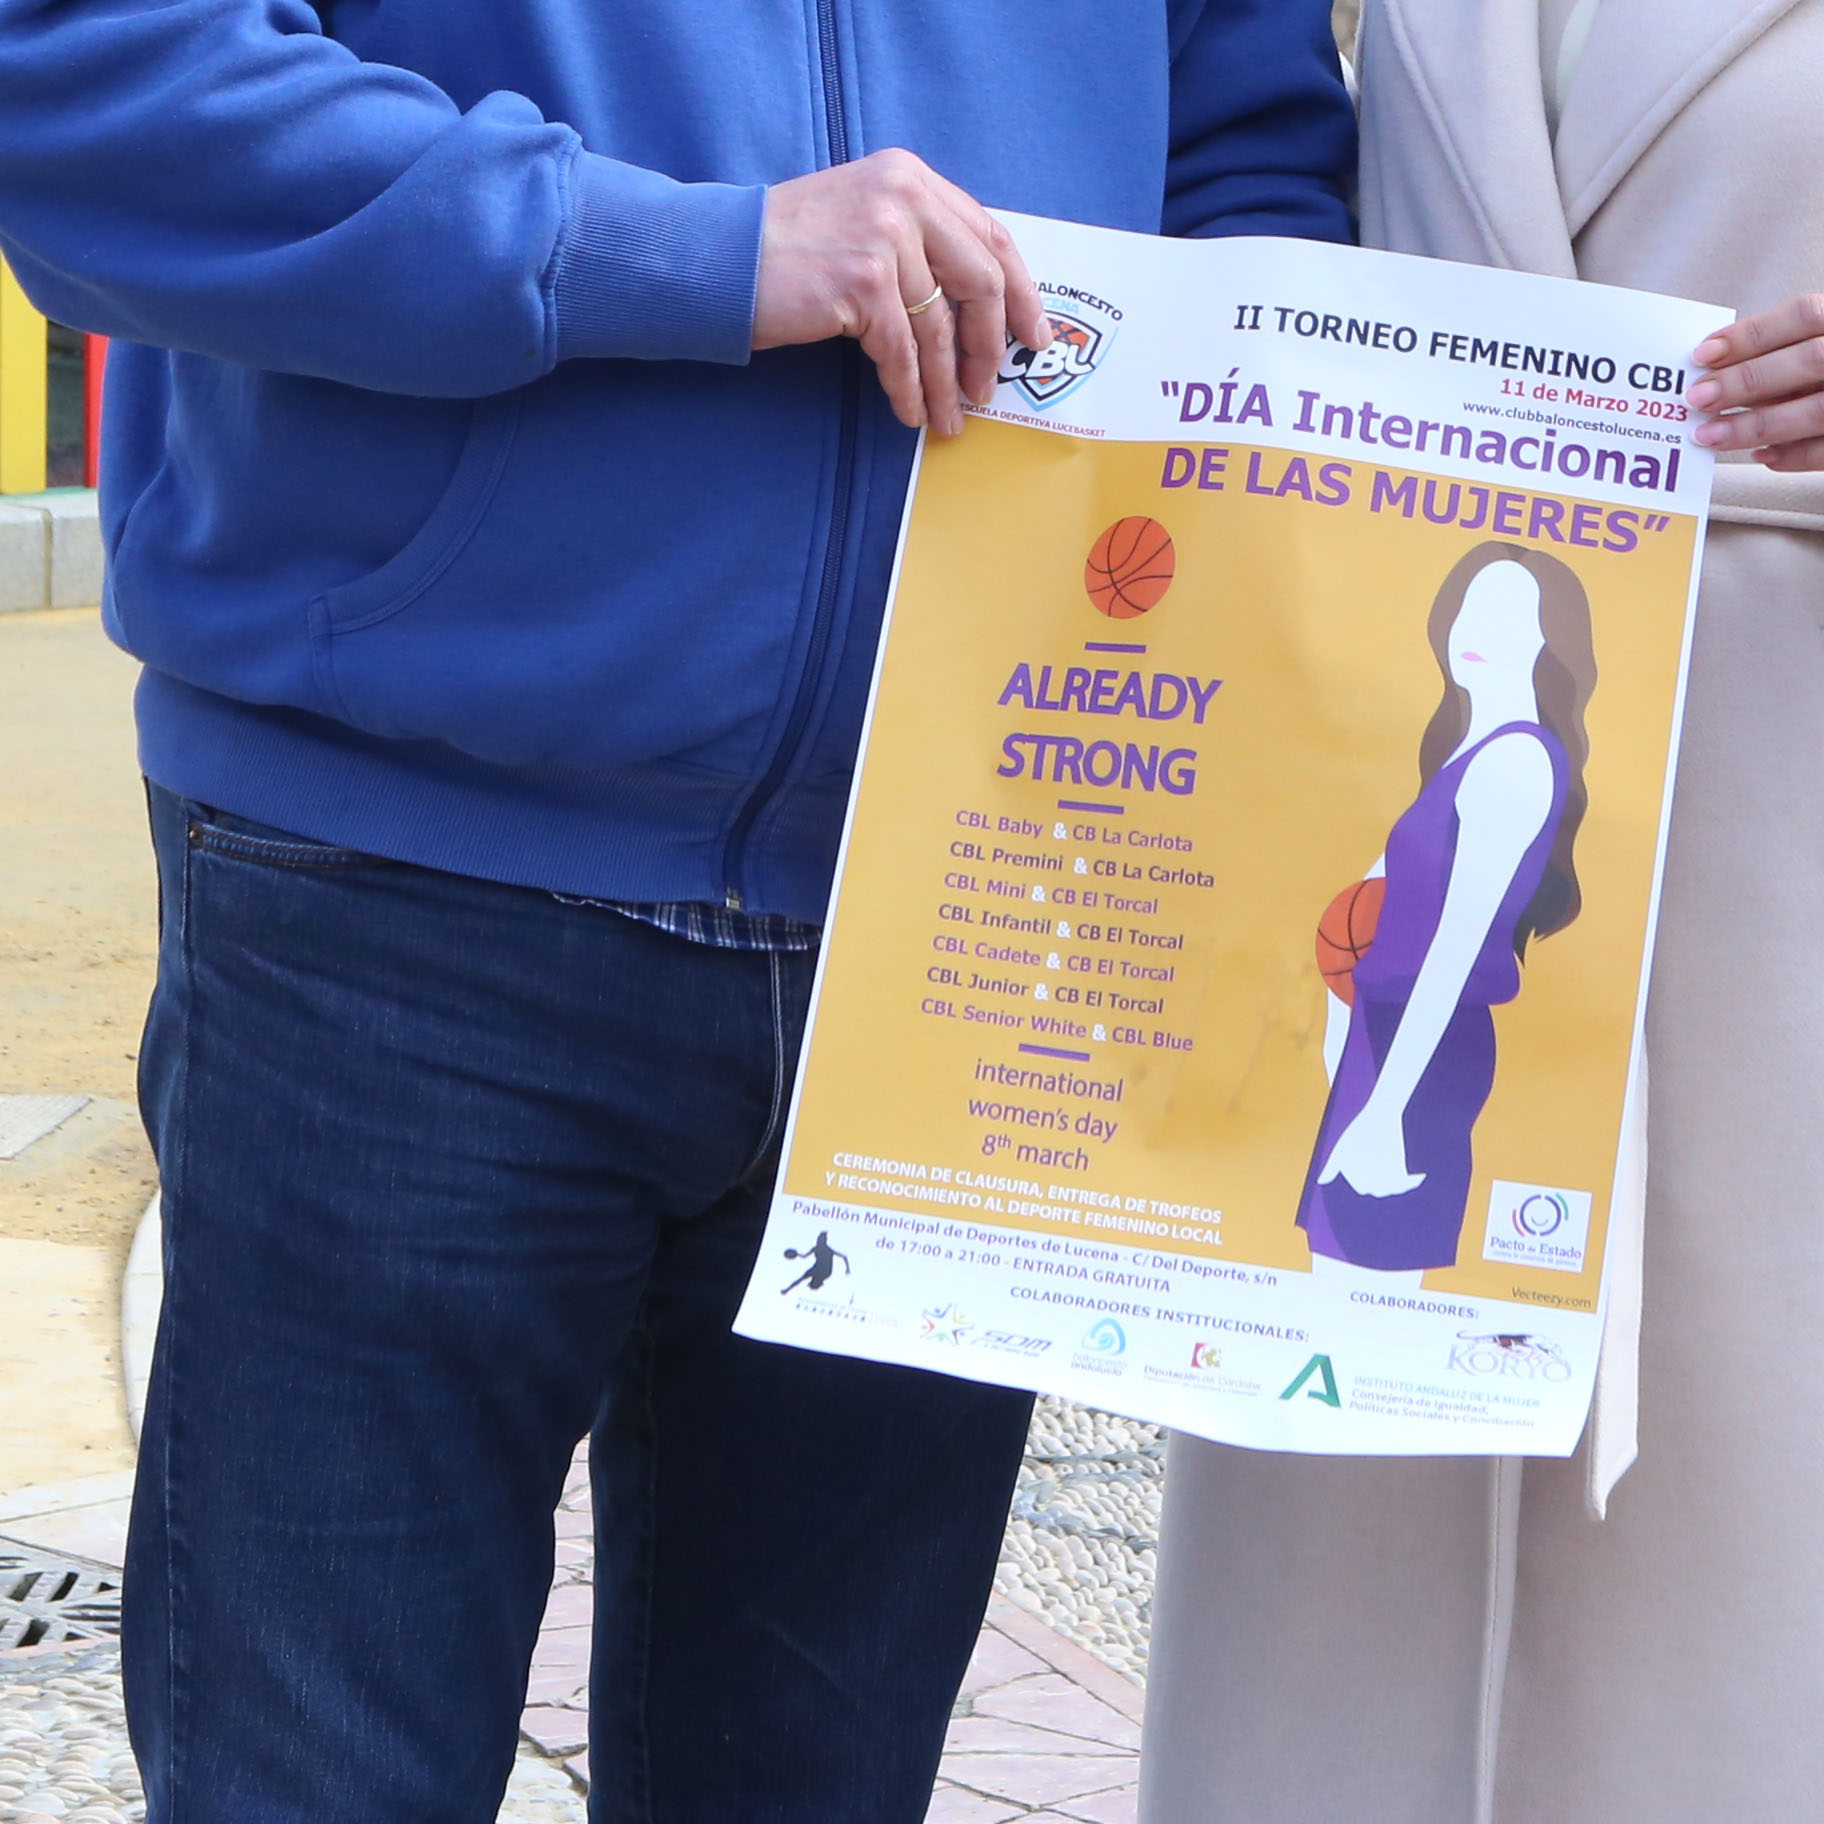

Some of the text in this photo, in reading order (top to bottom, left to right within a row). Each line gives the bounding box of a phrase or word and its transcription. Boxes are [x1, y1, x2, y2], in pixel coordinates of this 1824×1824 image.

[1033, 281, 1123, 321] ALONCESTO
[1233, 305, 1264, 330] II
[1274, 306, 1418, 353] TORNEO
[1429, 332, 1616, 384] FEMENINO
[960, 403, 1106, 438] ESCUELA DEPORTIVA LUCEBASKET
[1500, 378, 1688, 422] 11 de Marzo 2023
[1293, 389, 1681, 493] Internacional
[1463, 402, 1682, 444] www.clubbaloncestolucena.es
[1160, 448, 1229, 491] DE
[1245, 451, 1352, 507] LAS
[997, 662, 1224, 725] ALREADY
[997, 732, 1198, 796] STRONG
[955, 809, 1193, 852] CBL Baby & CB La Carlota
[949, 841, 1215, 888] CBL Premini & CB La Carlota
[944, 872, 1159, 914] CBL Mini & CB El Torcal
[938, 904, 1184, 951] CBL Infantil & CB El Torcal
[932, 935, 1175, 982] CBL Cadete & CB El Torcal
[926, 966, 1164, 1014] CBL Junior & CB El Torcal
[920, 998, 1194, 1052] CBL Senior White & CBL Blue
[975, 1058, 1124, 1102] international
[1074, 1111, 1119, 1144] day
[980, 1133, 1089, 1171] 8th march
[824, 1171, 1225, 1246] Y RECONOCIMIENTO AL DEPORTE FEMENINO LOCAL
[832, 1151, 1223, 1225] CEREMONIA DE CLAUSURA, ENTREGA DE TROFEOS
[792, 1200, 861, 1224] Pabellón
[863, 1211, 941, 1236] Municipal
[943, 1223, 964, 1239] de
[966, 1226, 1038, 1250] Deportes
[1041, 1239, 1061, 1254] de
[1064, 1241, 1119, 1262] Lucena
[1132, 1252, 1150, 1267] C/
[1152, 1254, 1178, 1272] Del
[1181, 1260, 1251, 1284] Deporte,
[1253, 1271, 1278, 1287] s/n
[875, 1236, 896, 1251] de
[900, 1240, 942, 1258] 17:00
[944, 1249, 954, 1260] a
[958, 1249, 1001, 1267] 21:00
[1013, 1256, 1089, 1281] ENTRADA
[1092, 1269, 1171, 1293] GRATUITA
[1490, 1236, 1525, 1252] Pacto
[1539, 1242, 1582, 1260] Estado
[1010, 1285, 1310, 1344] COLABORADORES INSTITUCIONALES:
[1349, 1290, 1480, 1321] COLABORADORES:
[1511, 1285, 1592, 1309] Vecteezy.com
[1444, 1342, 1573, 1383] KORYO
[1354, 1375, 1414, 1393] INSTITUTO
[1415, 1383, 1467, 1401] ANDALUZ
[1415, 1397, 1432, 1408] de
